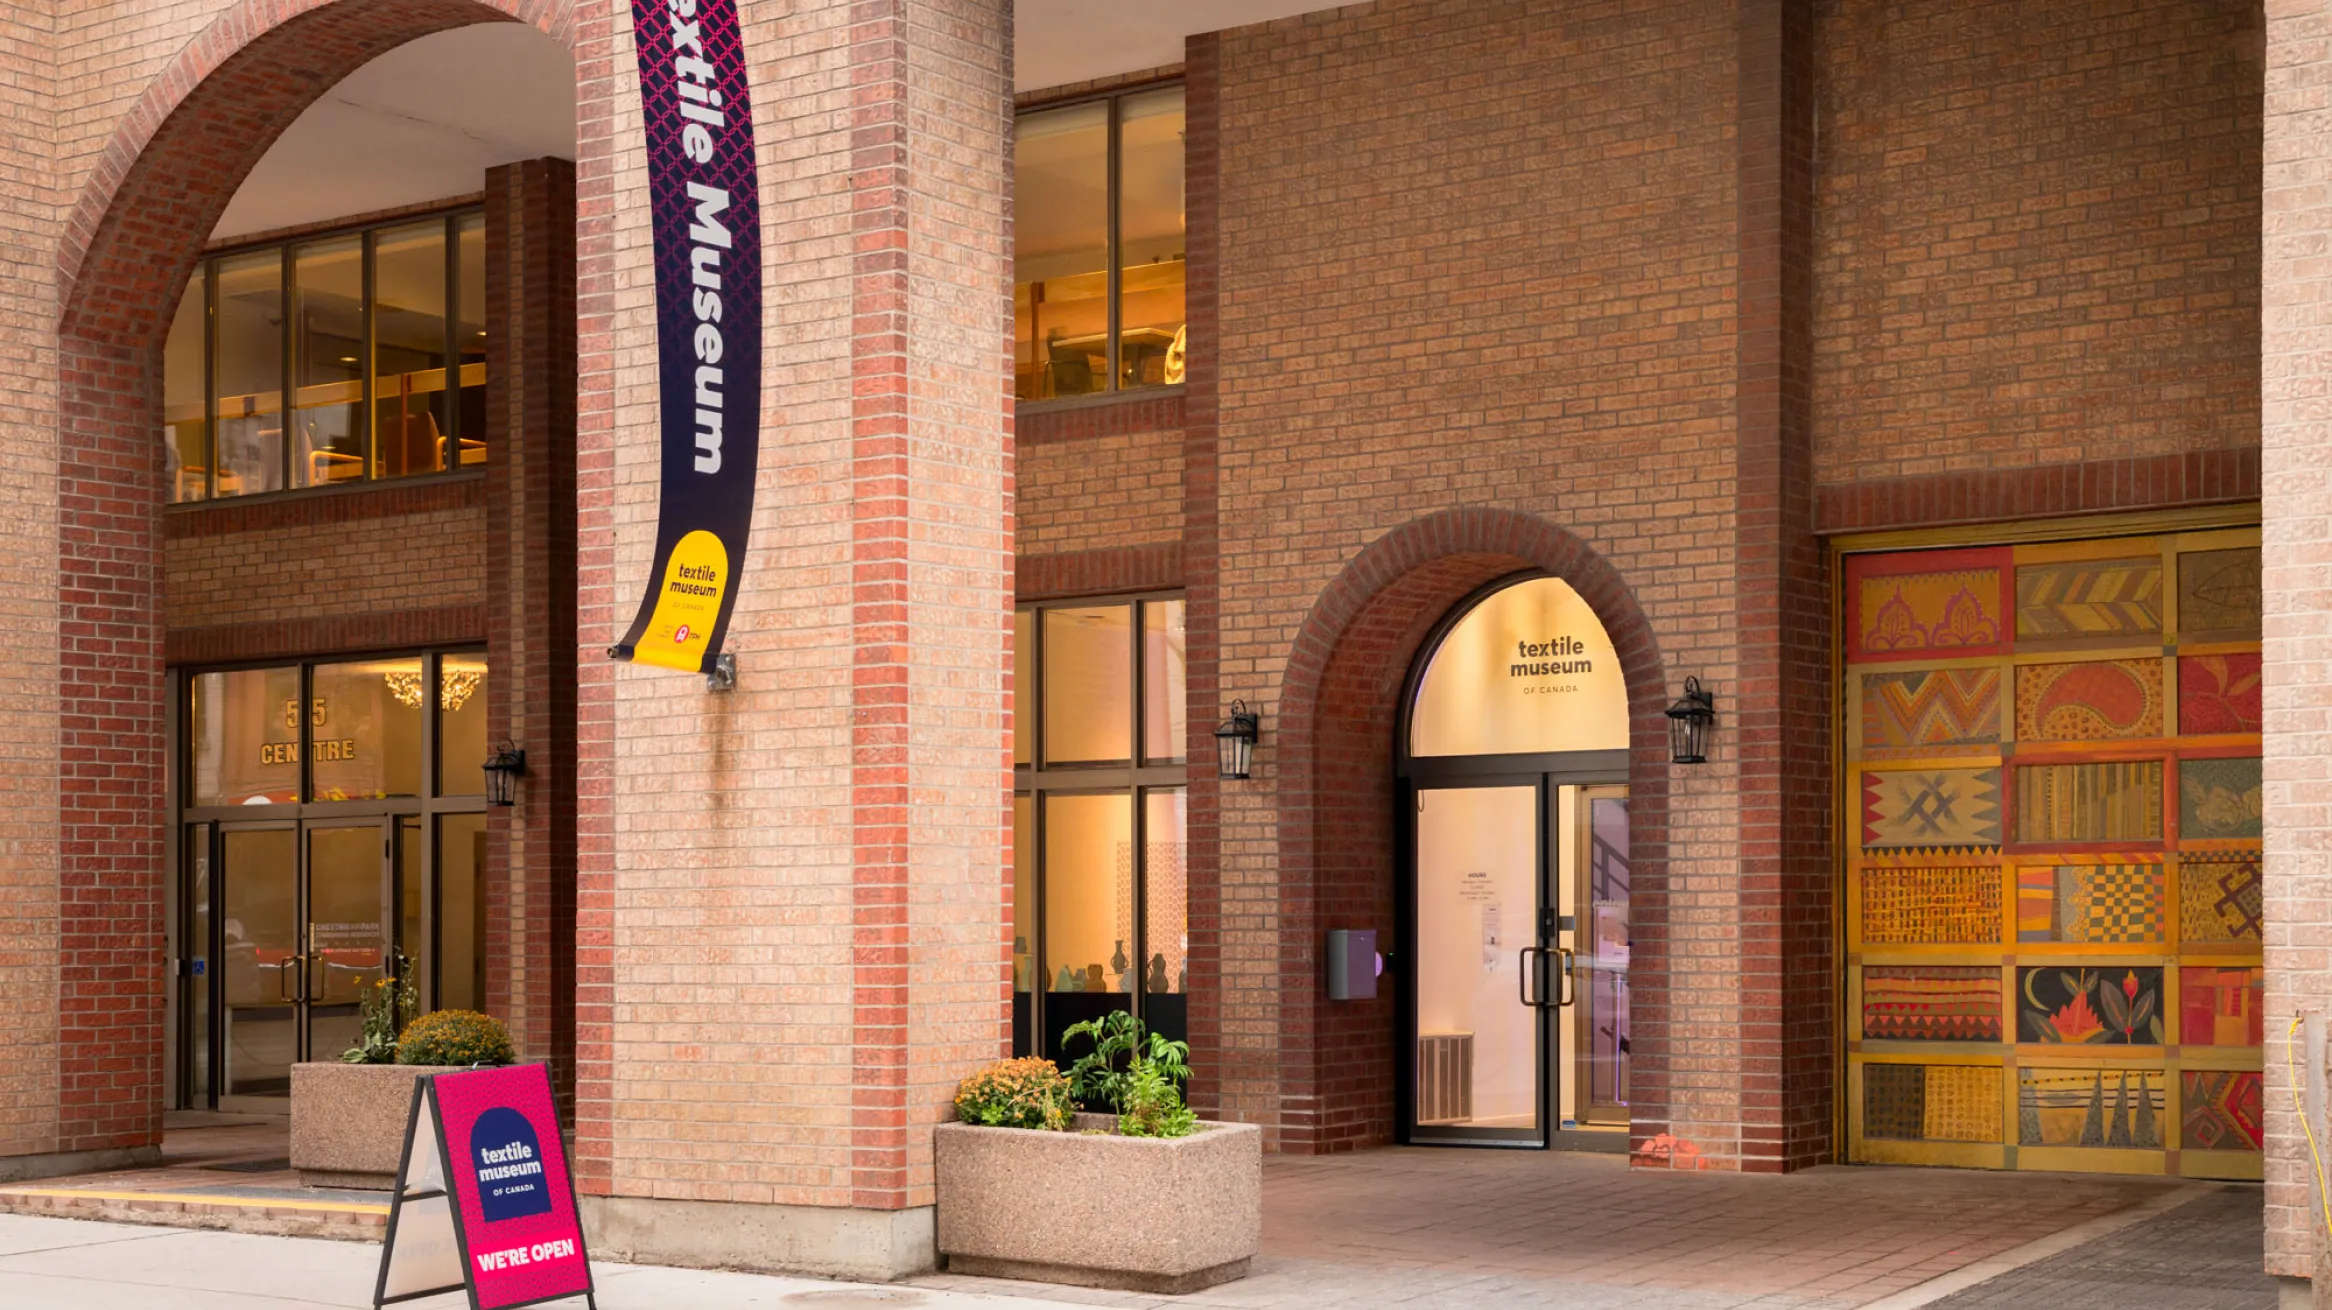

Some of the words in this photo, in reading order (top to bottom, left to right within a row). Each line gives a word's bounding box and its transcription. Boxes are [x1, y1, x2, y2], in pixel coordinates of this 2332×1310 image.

[686, 181, 732, 475] Museum
[679, 563, 716, 582] textile
[669, 581, 717, 598] museum
[1518, 635, 1584, 658] textile
[1510, 660, 1592, 677] museum
[1523, 687, 1535, 695] OF
[1539, 685, 1578, 694] CANADA
[261, 740, 355, 765] CENTRE
[481, 1141, 532, 1164] textile
[479, 1160, 541, 1182] museum
[493, 1188, 503, 1196] OF
[505, 1184, 534, 1195] CANADA
[477, 1247, 530, 1272] WE'RE
[531, 1238, 575, 1262] OPEN
